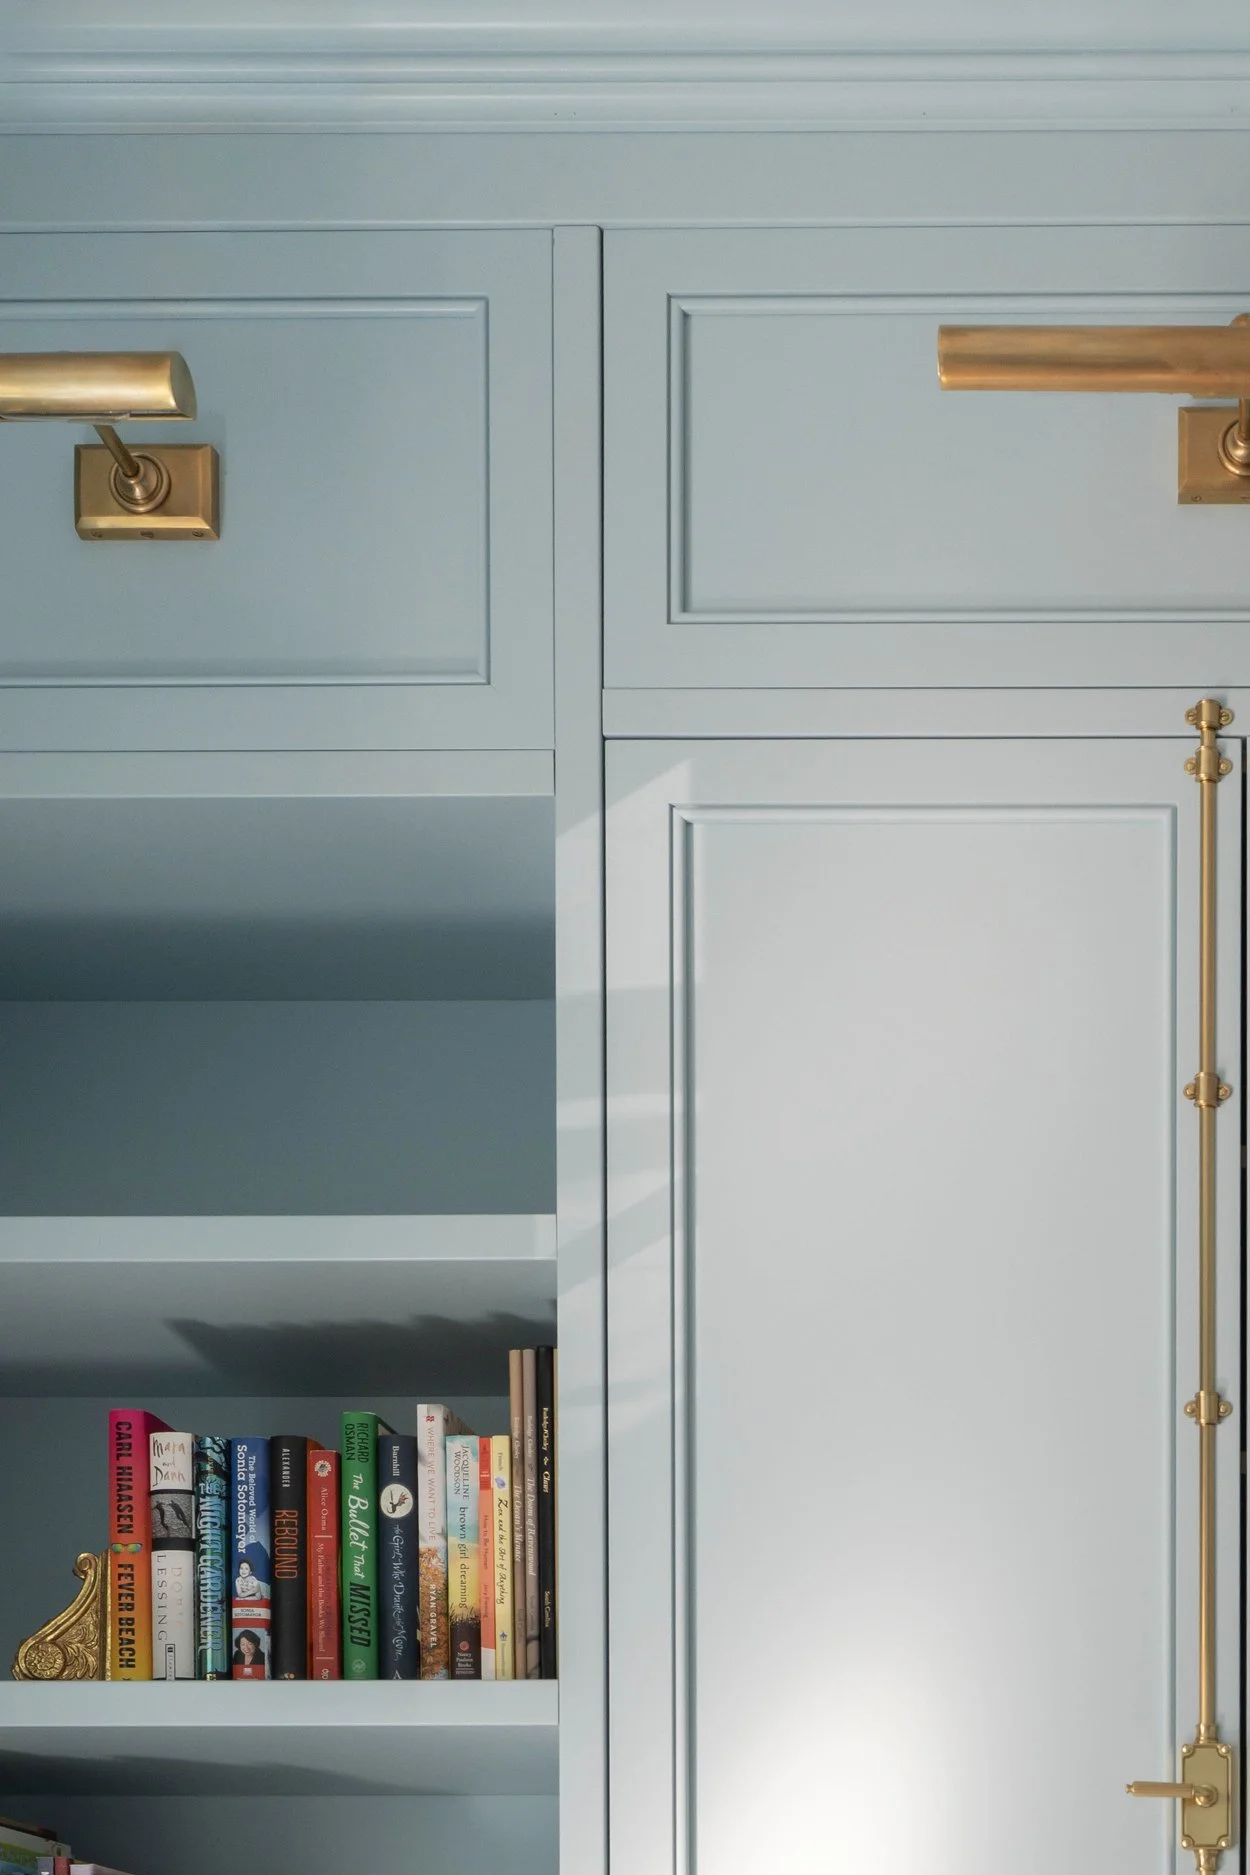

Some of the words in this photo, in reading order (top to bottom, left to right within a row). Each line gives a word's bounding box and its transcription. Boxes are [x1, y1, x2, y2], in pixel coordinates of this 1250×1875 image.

[115, 1421, 133, 1461] CARL
[152, 1436, 186, 1458] Mara
[345, 1423, 355, 1461] OSMAN
[356, 1422, 370, 1463] RICHARD
[427, 1427, 435, 1456] WHERE
[152, 1465, 186, 1487] Dann
[237, 1445, 247, 1480] Sonia
[248, 1456, 256, 1472] The
[282, 1448, 290, 1487] ALEXANDER
[392, 1445, 400, 1477] Barnhill
[427, 1461, 435, 1474] WE
[461, 1445, 469, 1500] JACQUELINE
[199, 1482, 221, 1495] THE
[248, 1473, 256, 1504] Beloved
[320, 1487, 328, 1506] Alice
[353, 1473, 364, 1490] The
[427, 1479, 436, 1504] WANT
[116, 1466, 134, 1534] HIAASEN
[428, 1508, 436, 1517] TO
[497, 1497, 508, 1516] Zen
[197, 1496, 222, 1553] NIGHT
[236, 1484, 247, 1554] Sotomayor
[320, 1508, 328, 1530] Ozma
[348, 1495, 369, 1552] Bullet
[428, 1521, 436, 1541] LIVE
[460, 1507, 468, 1540] brown
[249, 1535, 256, 1543] of
[274, 1510, 298, 1579] REBOUND
[458, 1543, 469, 1559] girl
[353, 1555, 365, 1579] That
[117, 1564, 135, 1612] FEVER
[157, 1554, 168, 1641] LESSING
[458, 1563, 469, 1609] dreaming
[198, 1554, 223, 1657] GARDENER
[348, 1581, 371, 1648] MISSED
[118, 1617, 136, 1669] BEACH
